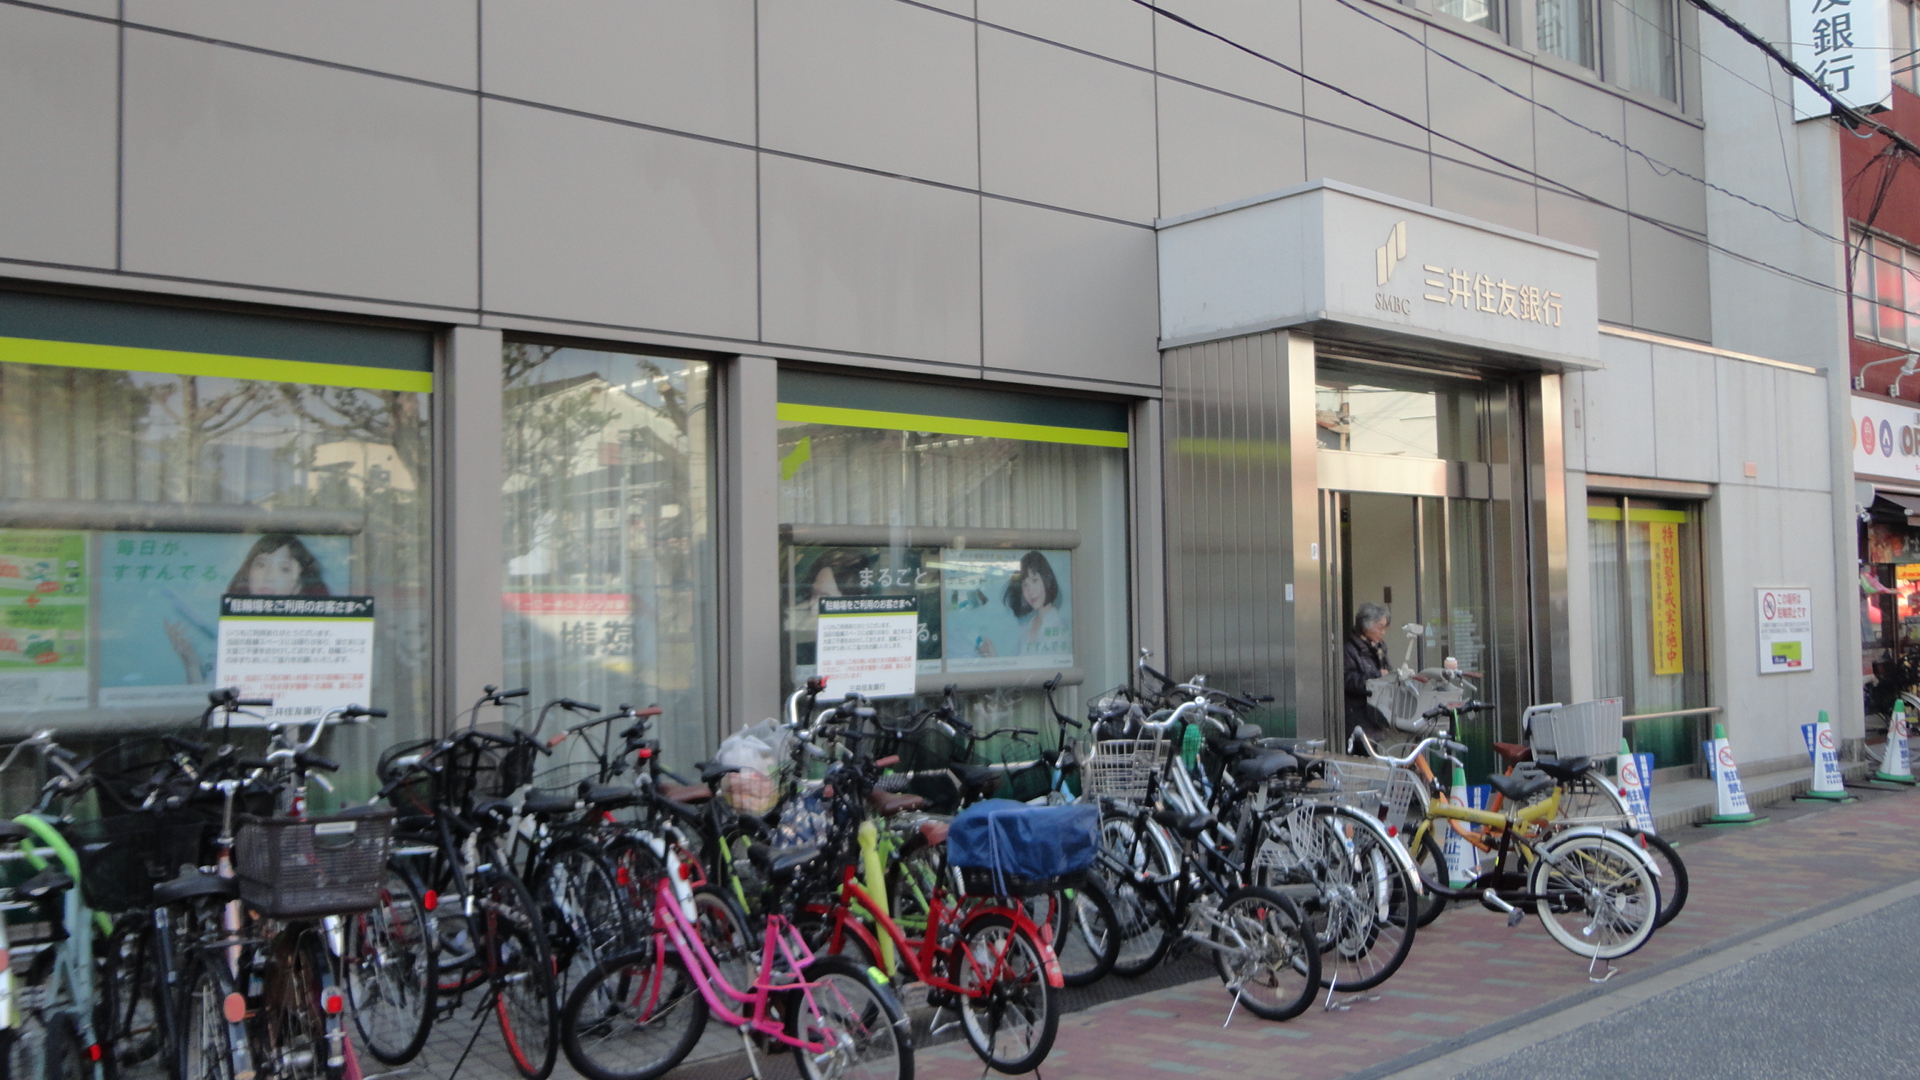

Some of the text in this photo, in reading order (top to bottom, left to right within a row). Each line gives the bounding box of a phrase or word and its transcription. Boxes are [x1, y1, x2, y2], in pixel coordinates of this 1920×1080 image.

[1374, 293, 1411, 316] SMBC
[1423, 264, 1563, 327] 三井住友銀行
[859, 567, 928, 588] まるごと
[825, 599, 912, 611] 駐輪場をご利用のお客さまへ
[1661, 525, 1677, 668] 特別警戒実施中
[266, 706, 322, 717] 三井住友銀行
